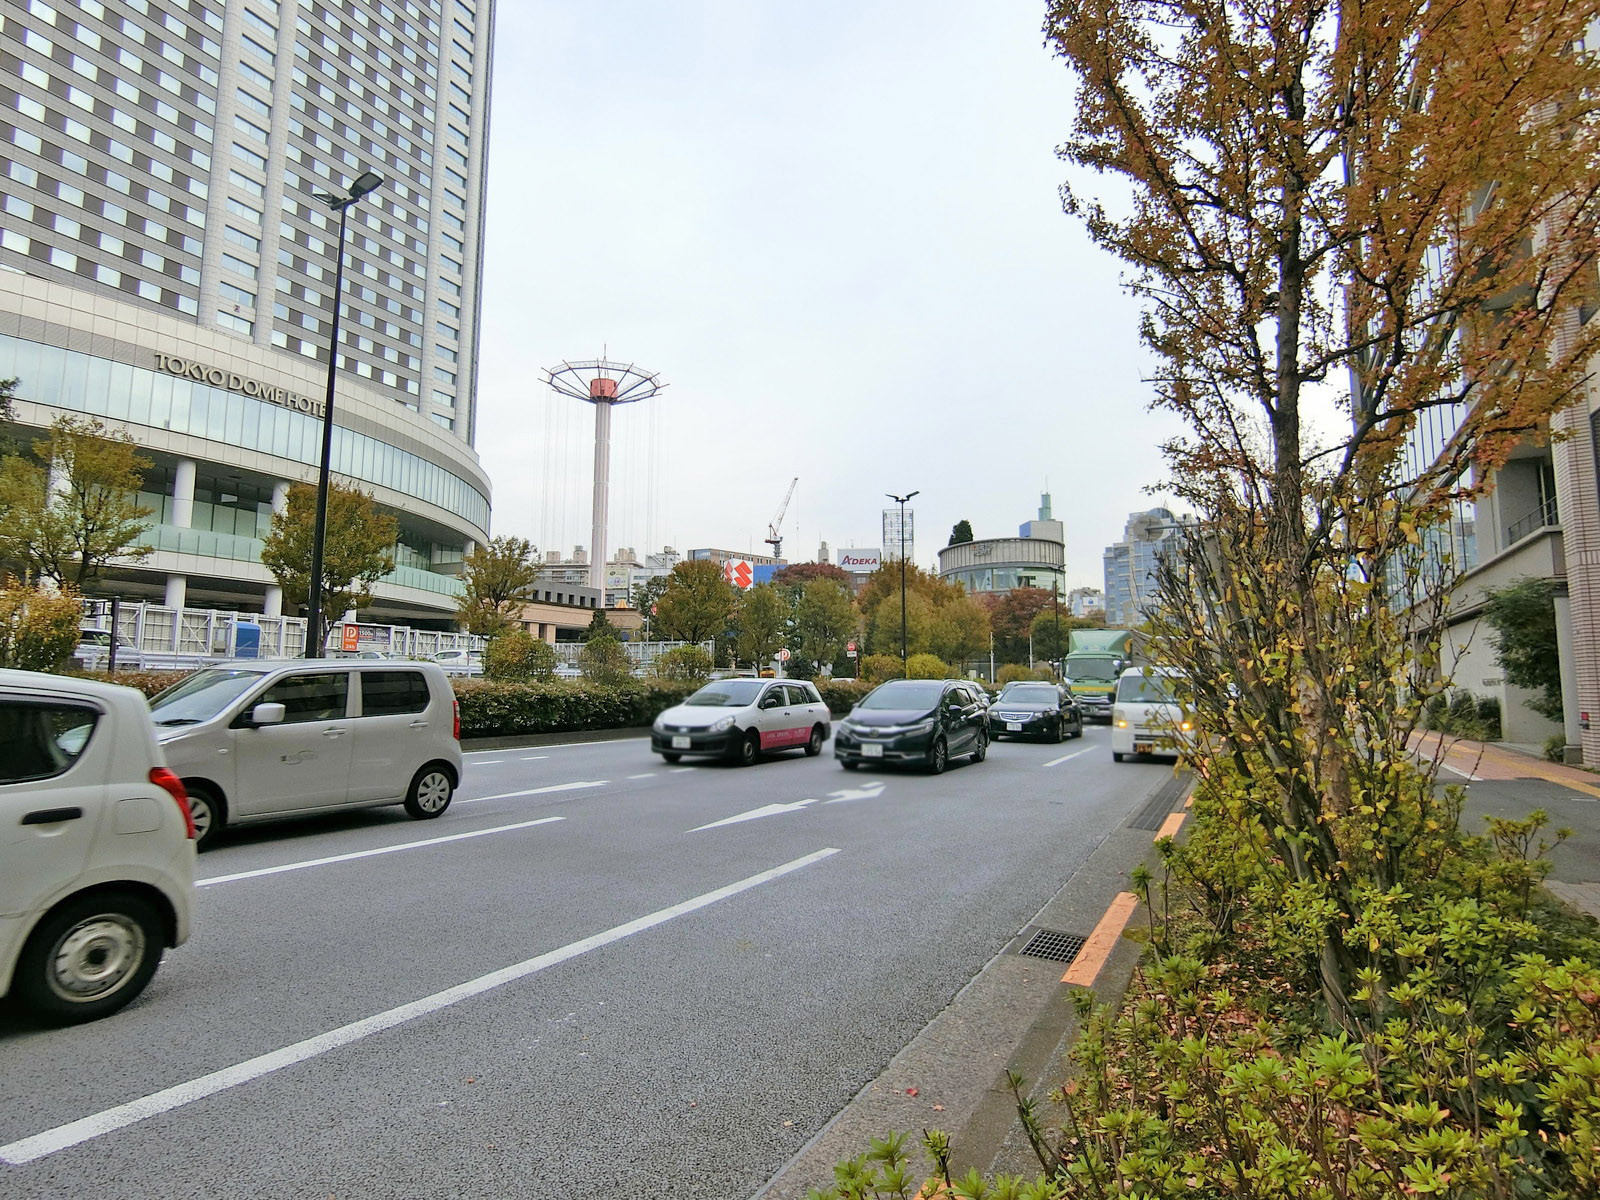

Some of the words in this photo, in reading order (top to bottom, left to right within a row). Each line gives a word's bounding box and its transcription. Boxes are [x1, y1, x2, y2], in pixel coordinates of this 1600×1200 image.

[154, 352, 225, 386] TOKYO
[228, 374, 283, 405] DOME
[285, 394, 327, 418] HOTE
[840, 555, 877, 566] ADEKA
